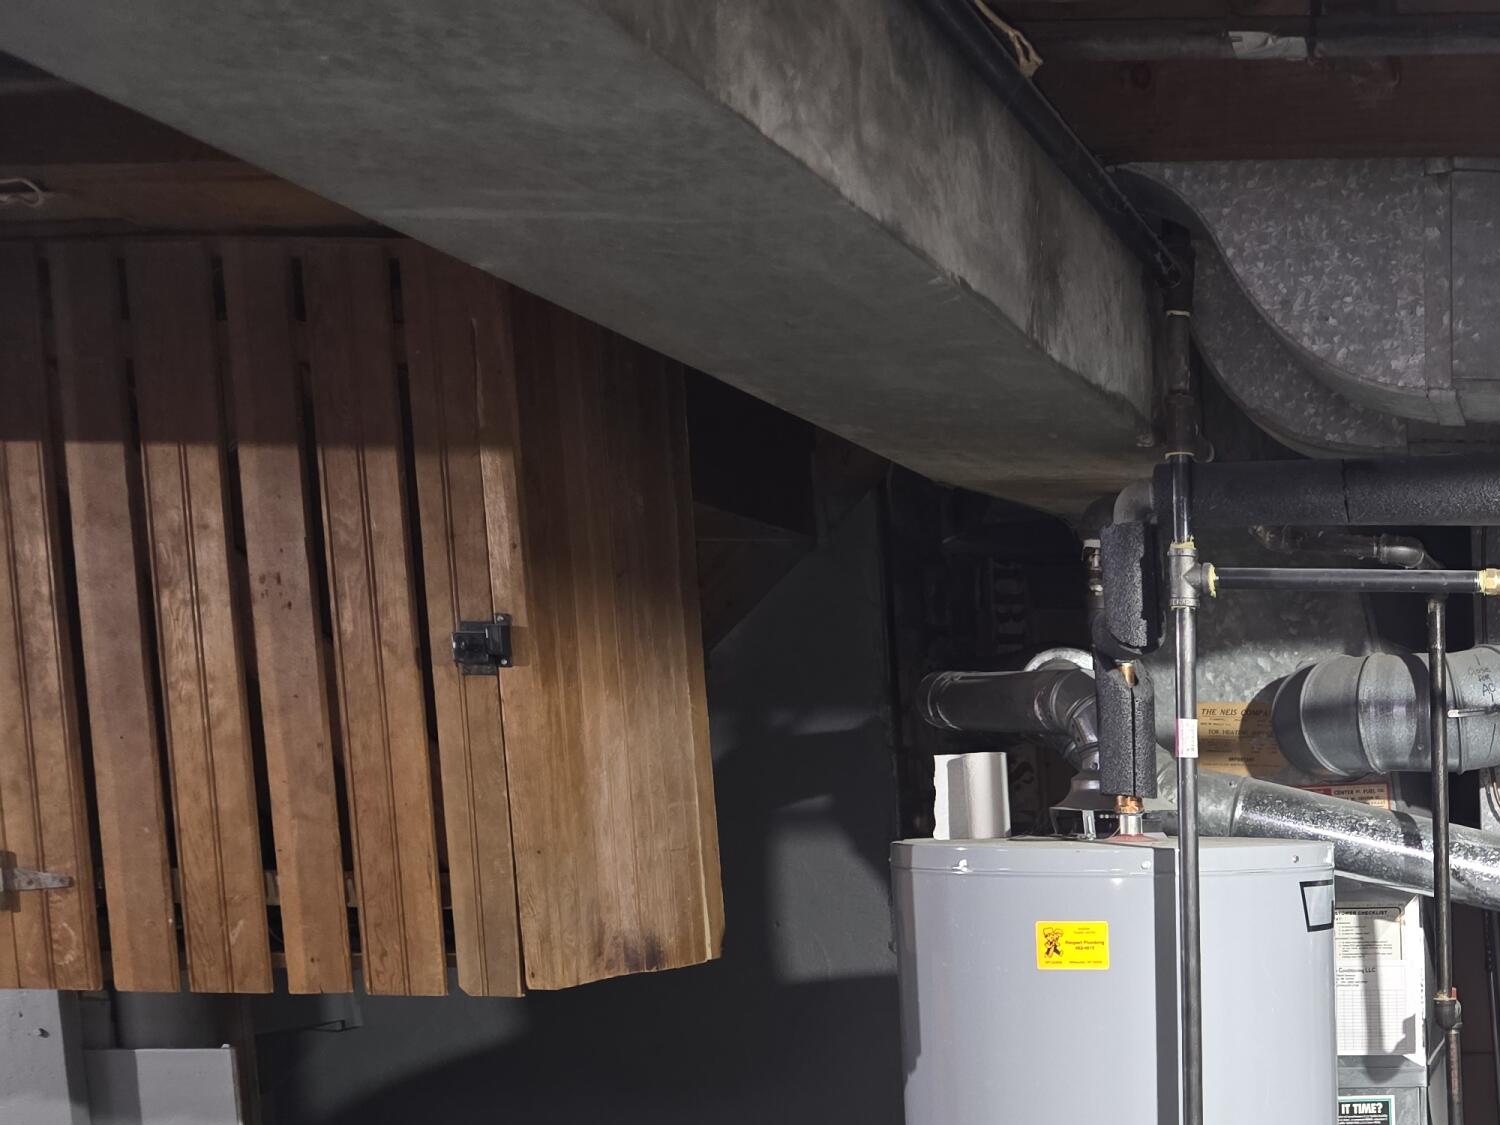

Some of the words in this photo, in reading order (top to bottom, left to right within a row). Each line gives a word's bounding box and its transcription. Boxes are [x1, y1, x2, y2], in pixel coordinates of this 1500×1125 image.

[1482, 683, 1495, 696] AC
[1201, 708, 1217, 716] THE
[1341, 1103, 1350, 1115] IT
[1352, 1102, 1383, 1114] TIME?
